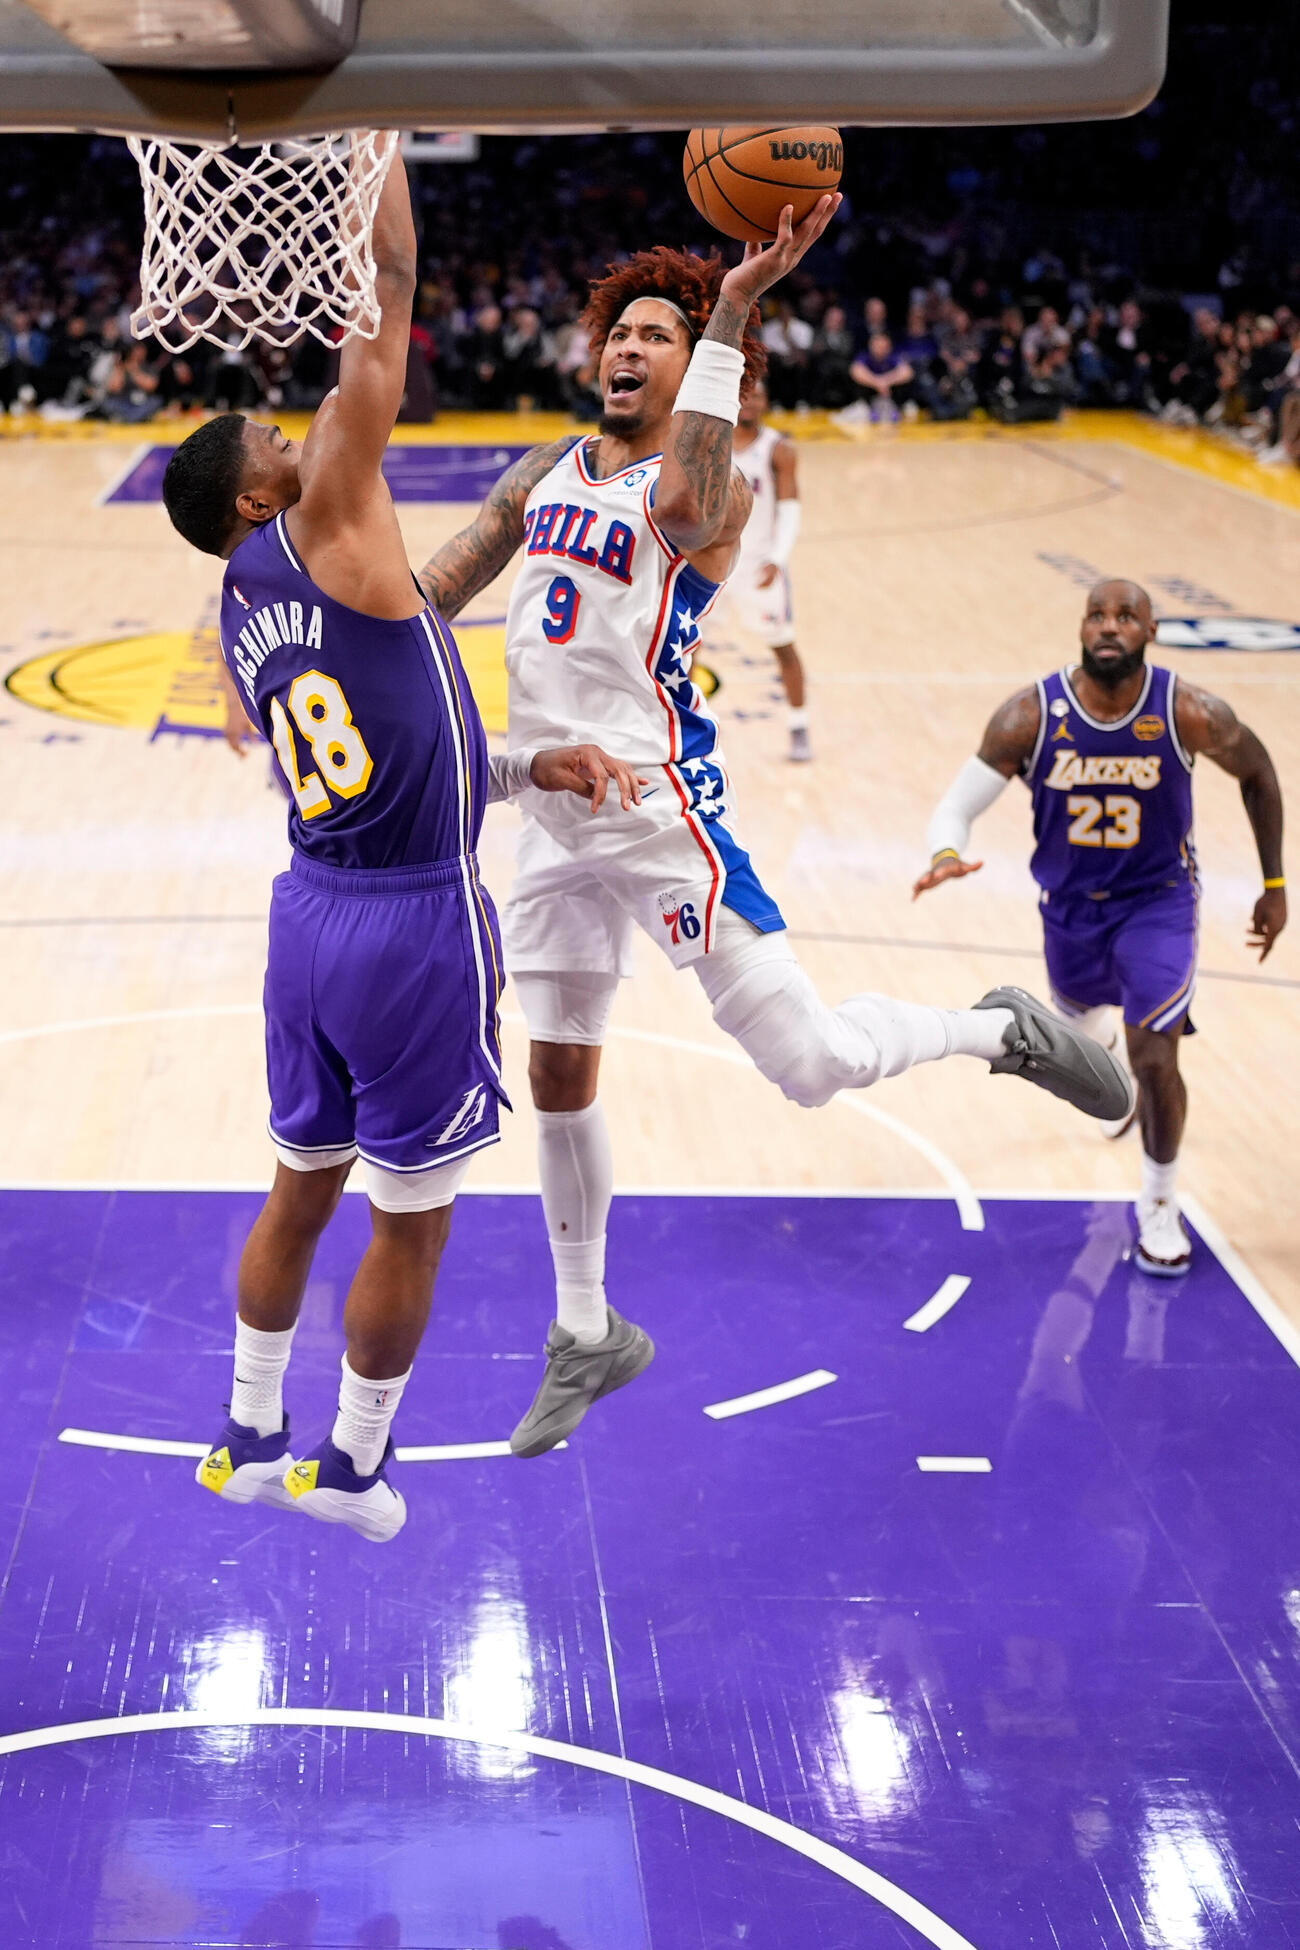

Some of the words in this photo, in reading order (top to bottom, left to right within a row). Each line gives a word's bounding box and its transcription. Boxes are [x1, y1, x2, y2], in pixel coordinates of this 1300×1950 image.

[523, 503, 636, 586] PHILA
[542, 576, 582, 645] 9
[1043, 749, 1162, 791] LAKERS
[1067, 795, 1142, 849] 23
[662, 902, 701, 946] 76
